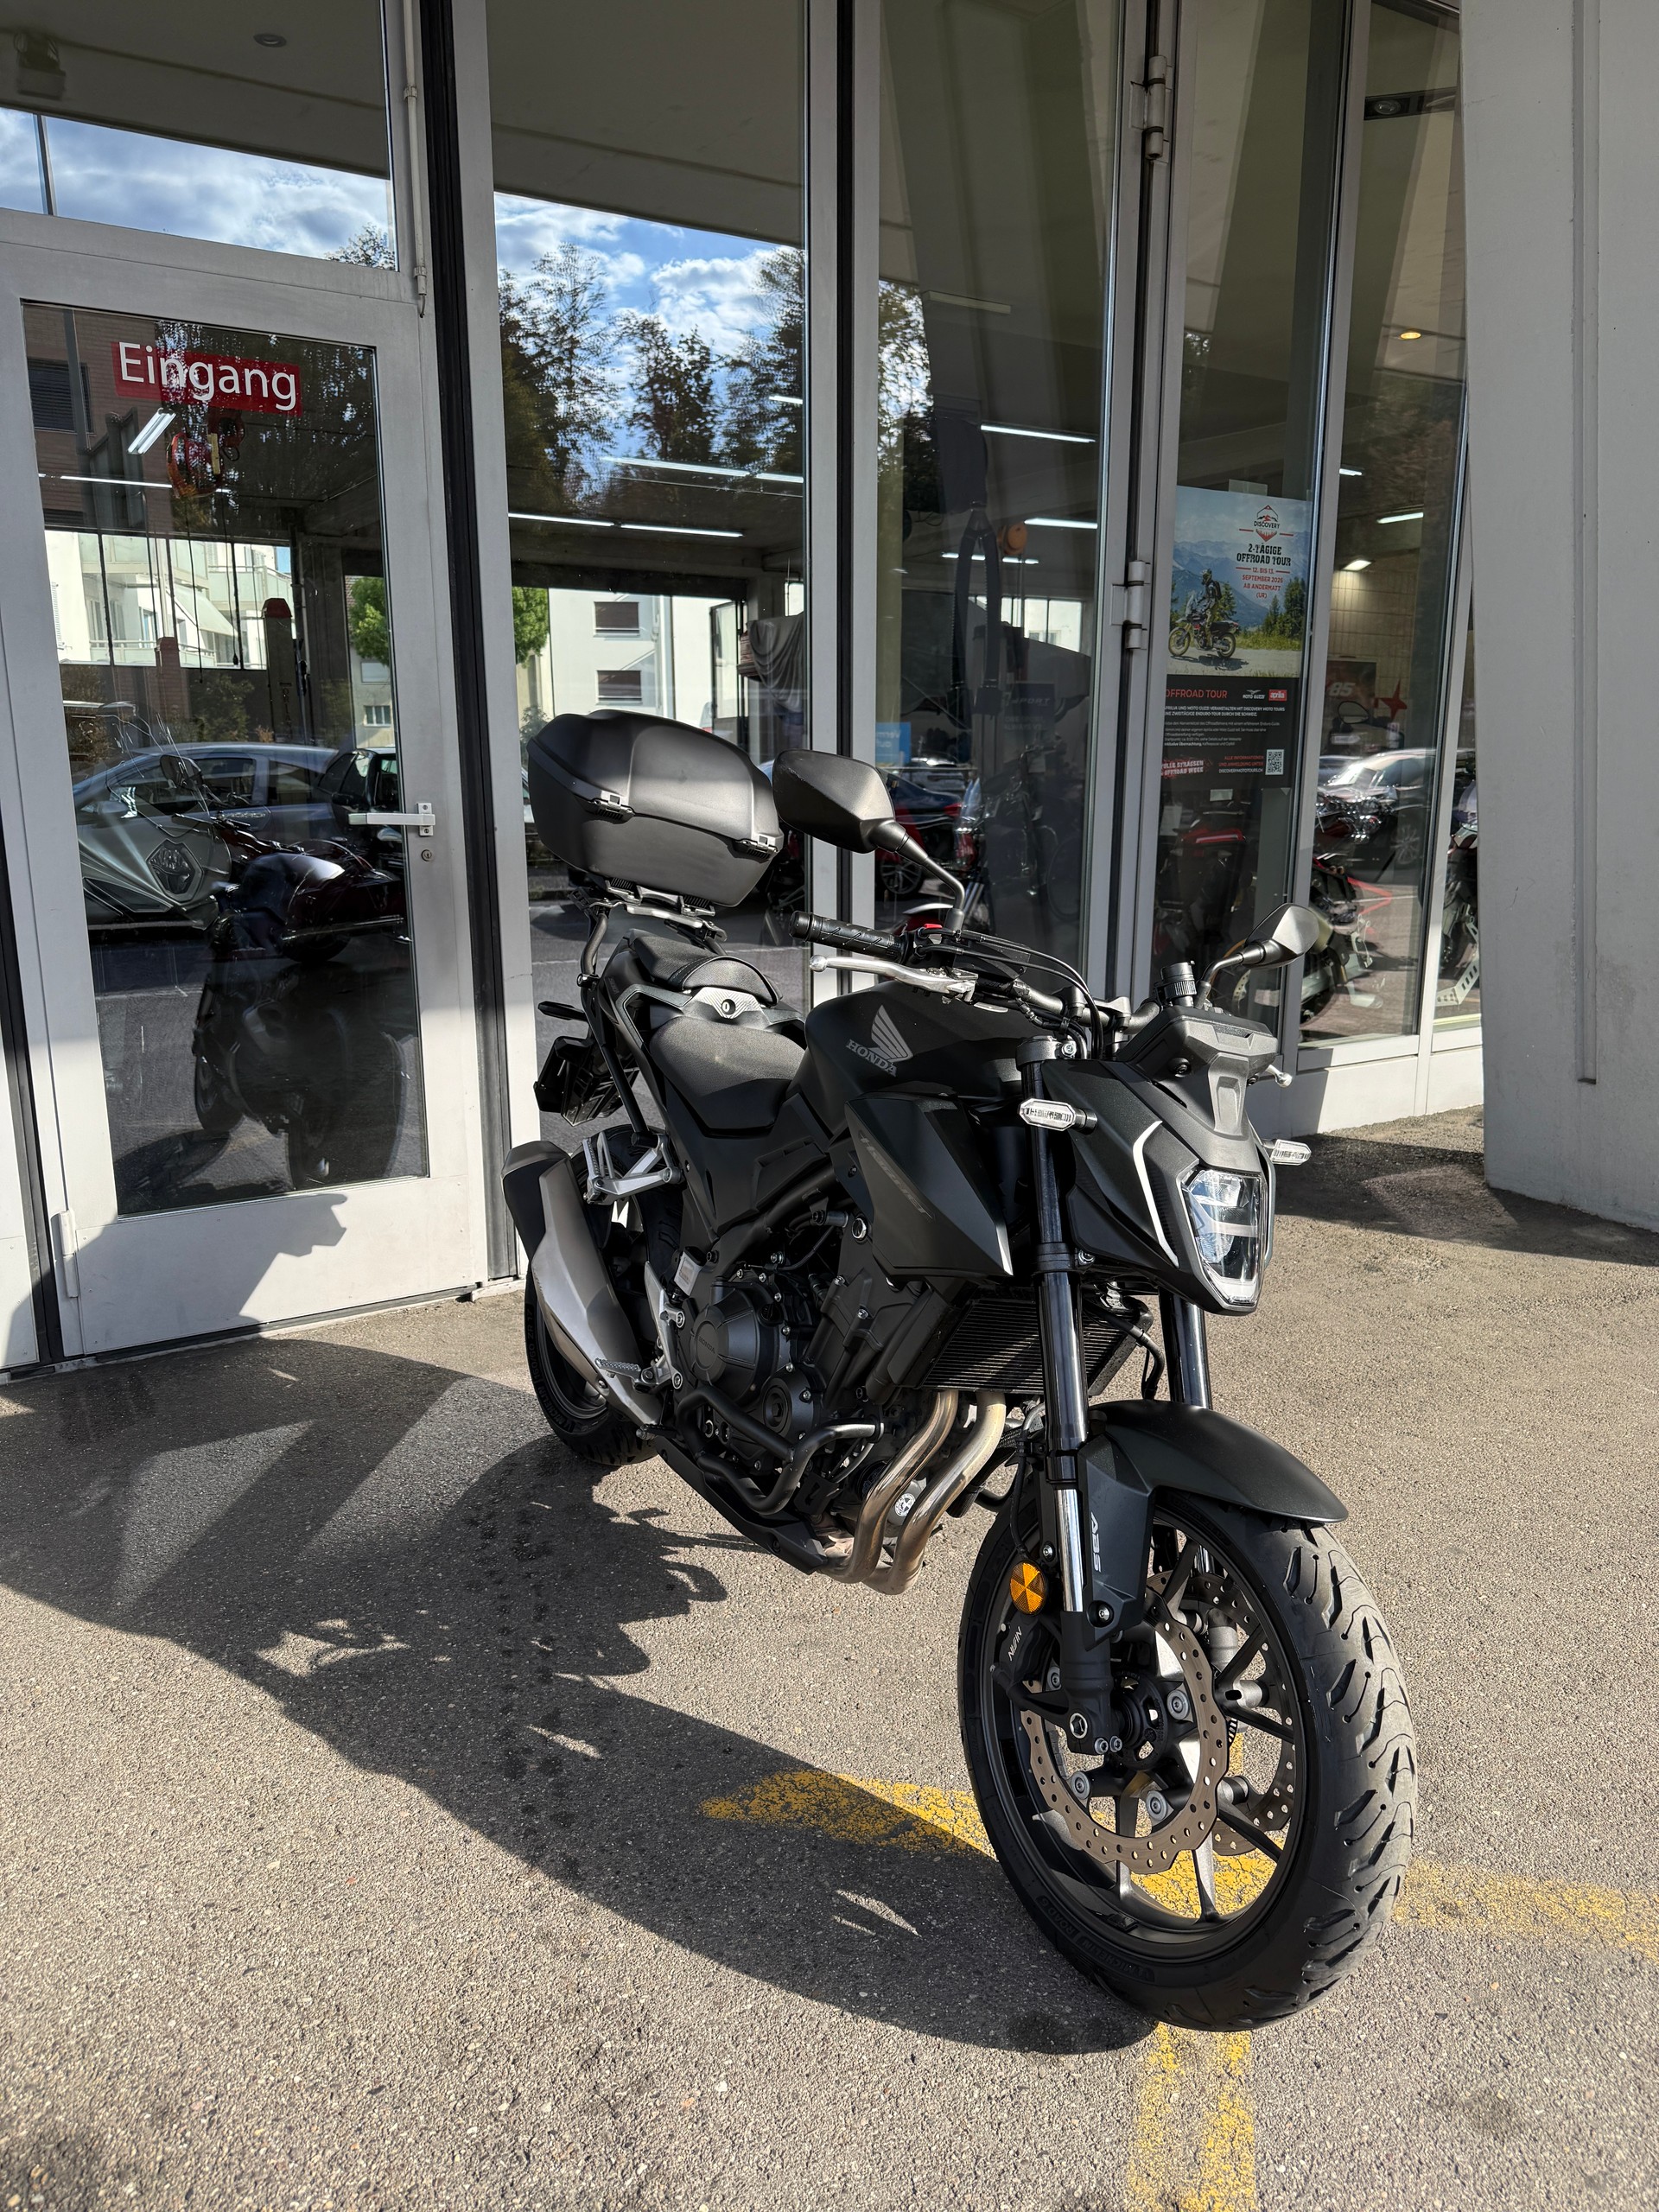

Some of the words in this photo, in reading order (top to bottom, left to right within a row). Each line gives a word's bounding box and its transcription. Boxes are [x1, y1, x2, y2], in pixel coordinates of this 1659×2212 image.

[119, 341, 297, 412] Eingang
[1254, 520, 1281, 529] DISCOVERY
[1236, 553, 1270, 565] OFFROAD
[1272, 556, 1291, 567] TOUR
[1249, 543, 1282, 556] 2-TÄGIGE
[1166, 689, 1205, 698] OFFROAD
[1206, 690, 1228, 699] TOUR
[846, 1039, 897, 1077] HONDA
[698, 1336, 715, 1354] HONDA
[537, 1385, 566, 1425] MICHELIN
[1090, 1511, 1102, 1573] ABS
[1039, 1897, 1049, 1907] 6
[1046, 1906, 1077, 1935] ROAD
[1081, 1938, 1136, 1974] MICHELIN
